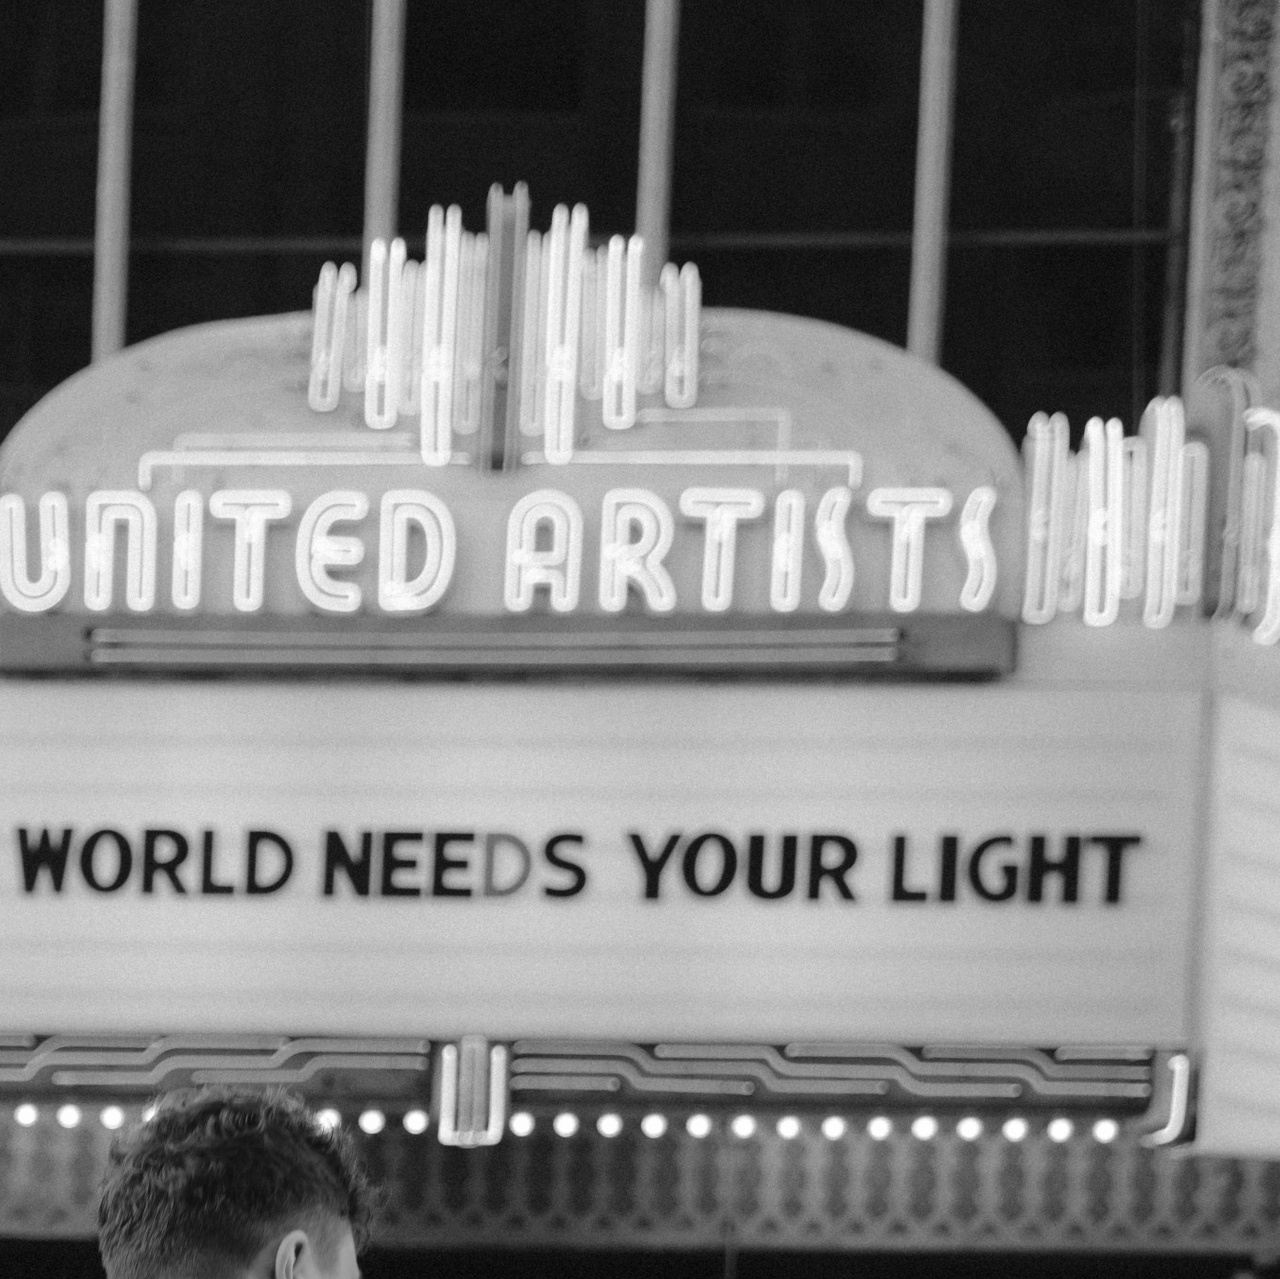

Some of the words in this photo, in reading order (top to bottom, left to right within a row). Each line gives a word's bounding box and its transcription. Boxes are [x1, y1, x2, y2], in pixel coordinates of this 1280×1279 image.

[504, 486, 998, 613] ARTISTS
[17, 827, 296, 897] WORLD
[322, 830, 589, 899] NEEDS
[628, 831, 860, 902] YOUR
[890, 834, 1143, 905] LIGHT
